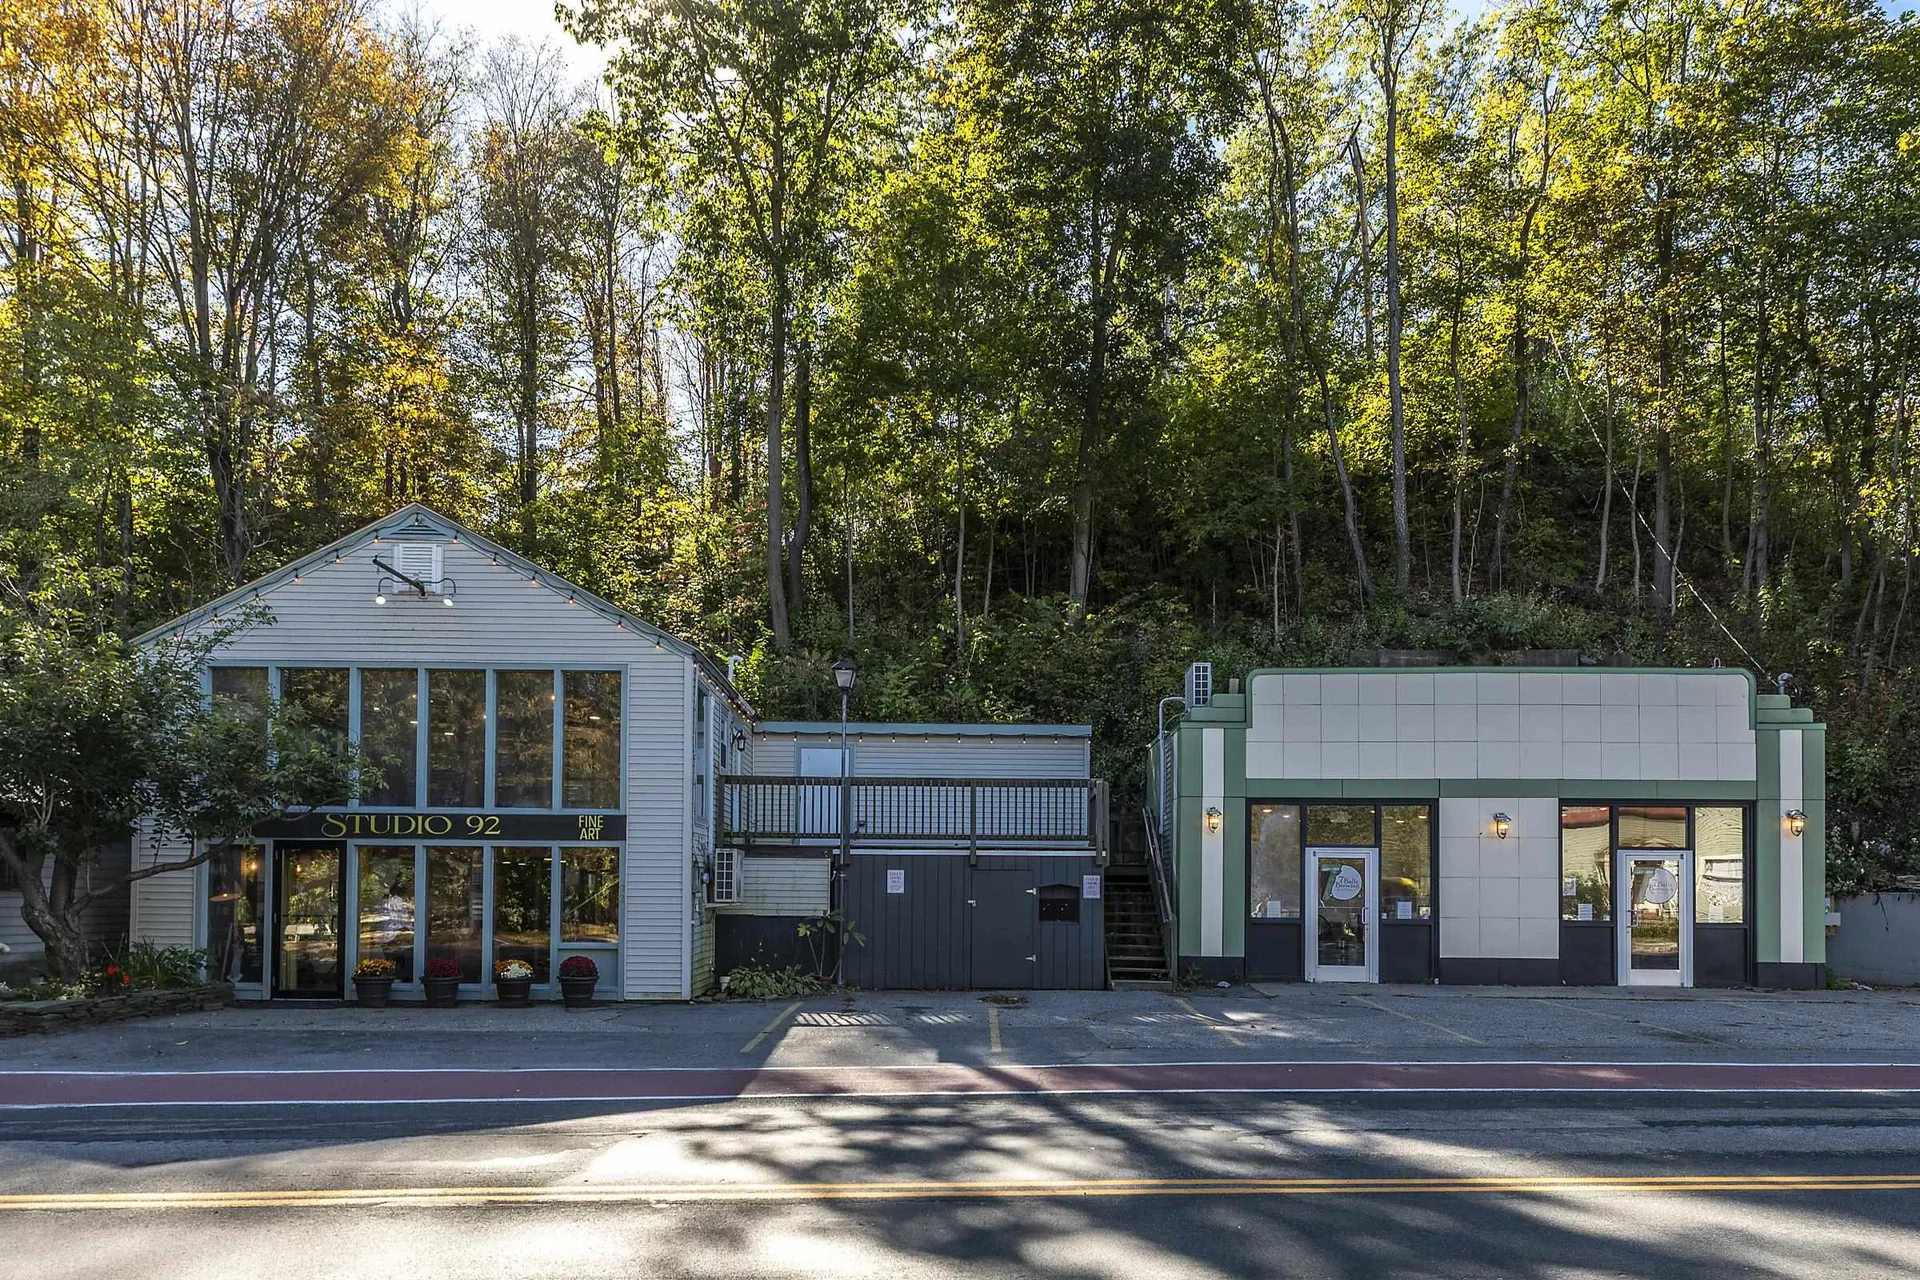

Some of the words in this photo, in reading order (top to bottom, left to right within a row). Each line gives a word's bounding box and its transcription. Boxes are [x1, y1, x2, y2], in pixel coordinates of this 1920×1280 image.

[321, 813, 452, 838] STUDIO
[466, 815, 501, 836] 92
[579, 815, 603, 828] FINE
[580, 828, 601, 840] ART
